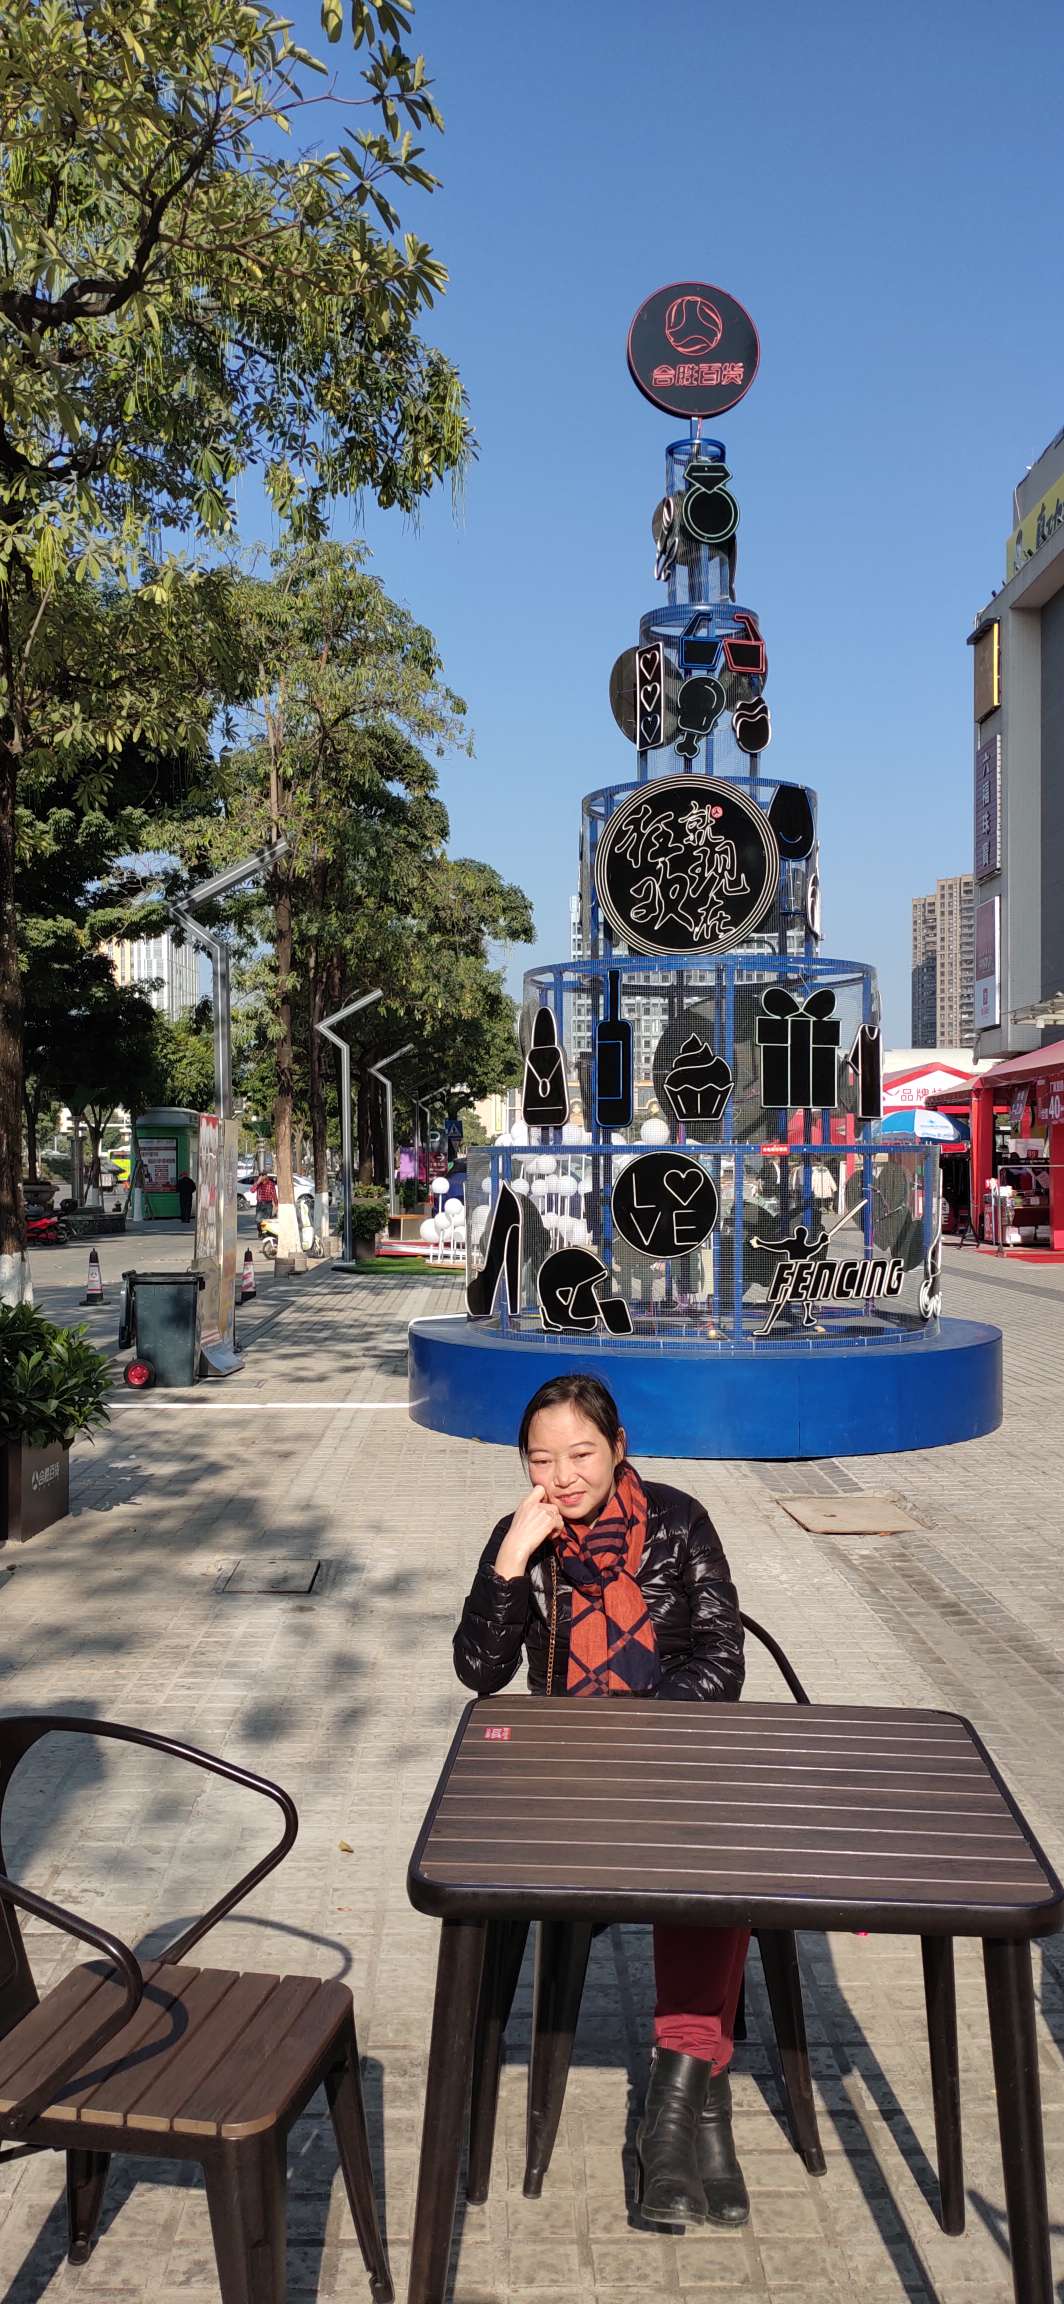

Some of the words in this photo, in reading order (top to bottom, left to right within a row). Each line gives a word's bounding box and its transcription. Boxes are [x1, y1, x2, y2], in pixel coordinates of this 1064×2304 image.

[651, 362, 744, 387] 合胜百货
[901, 1088, 943, 1101] 品牌
[767, 1258, 905, 1302] FENCING
